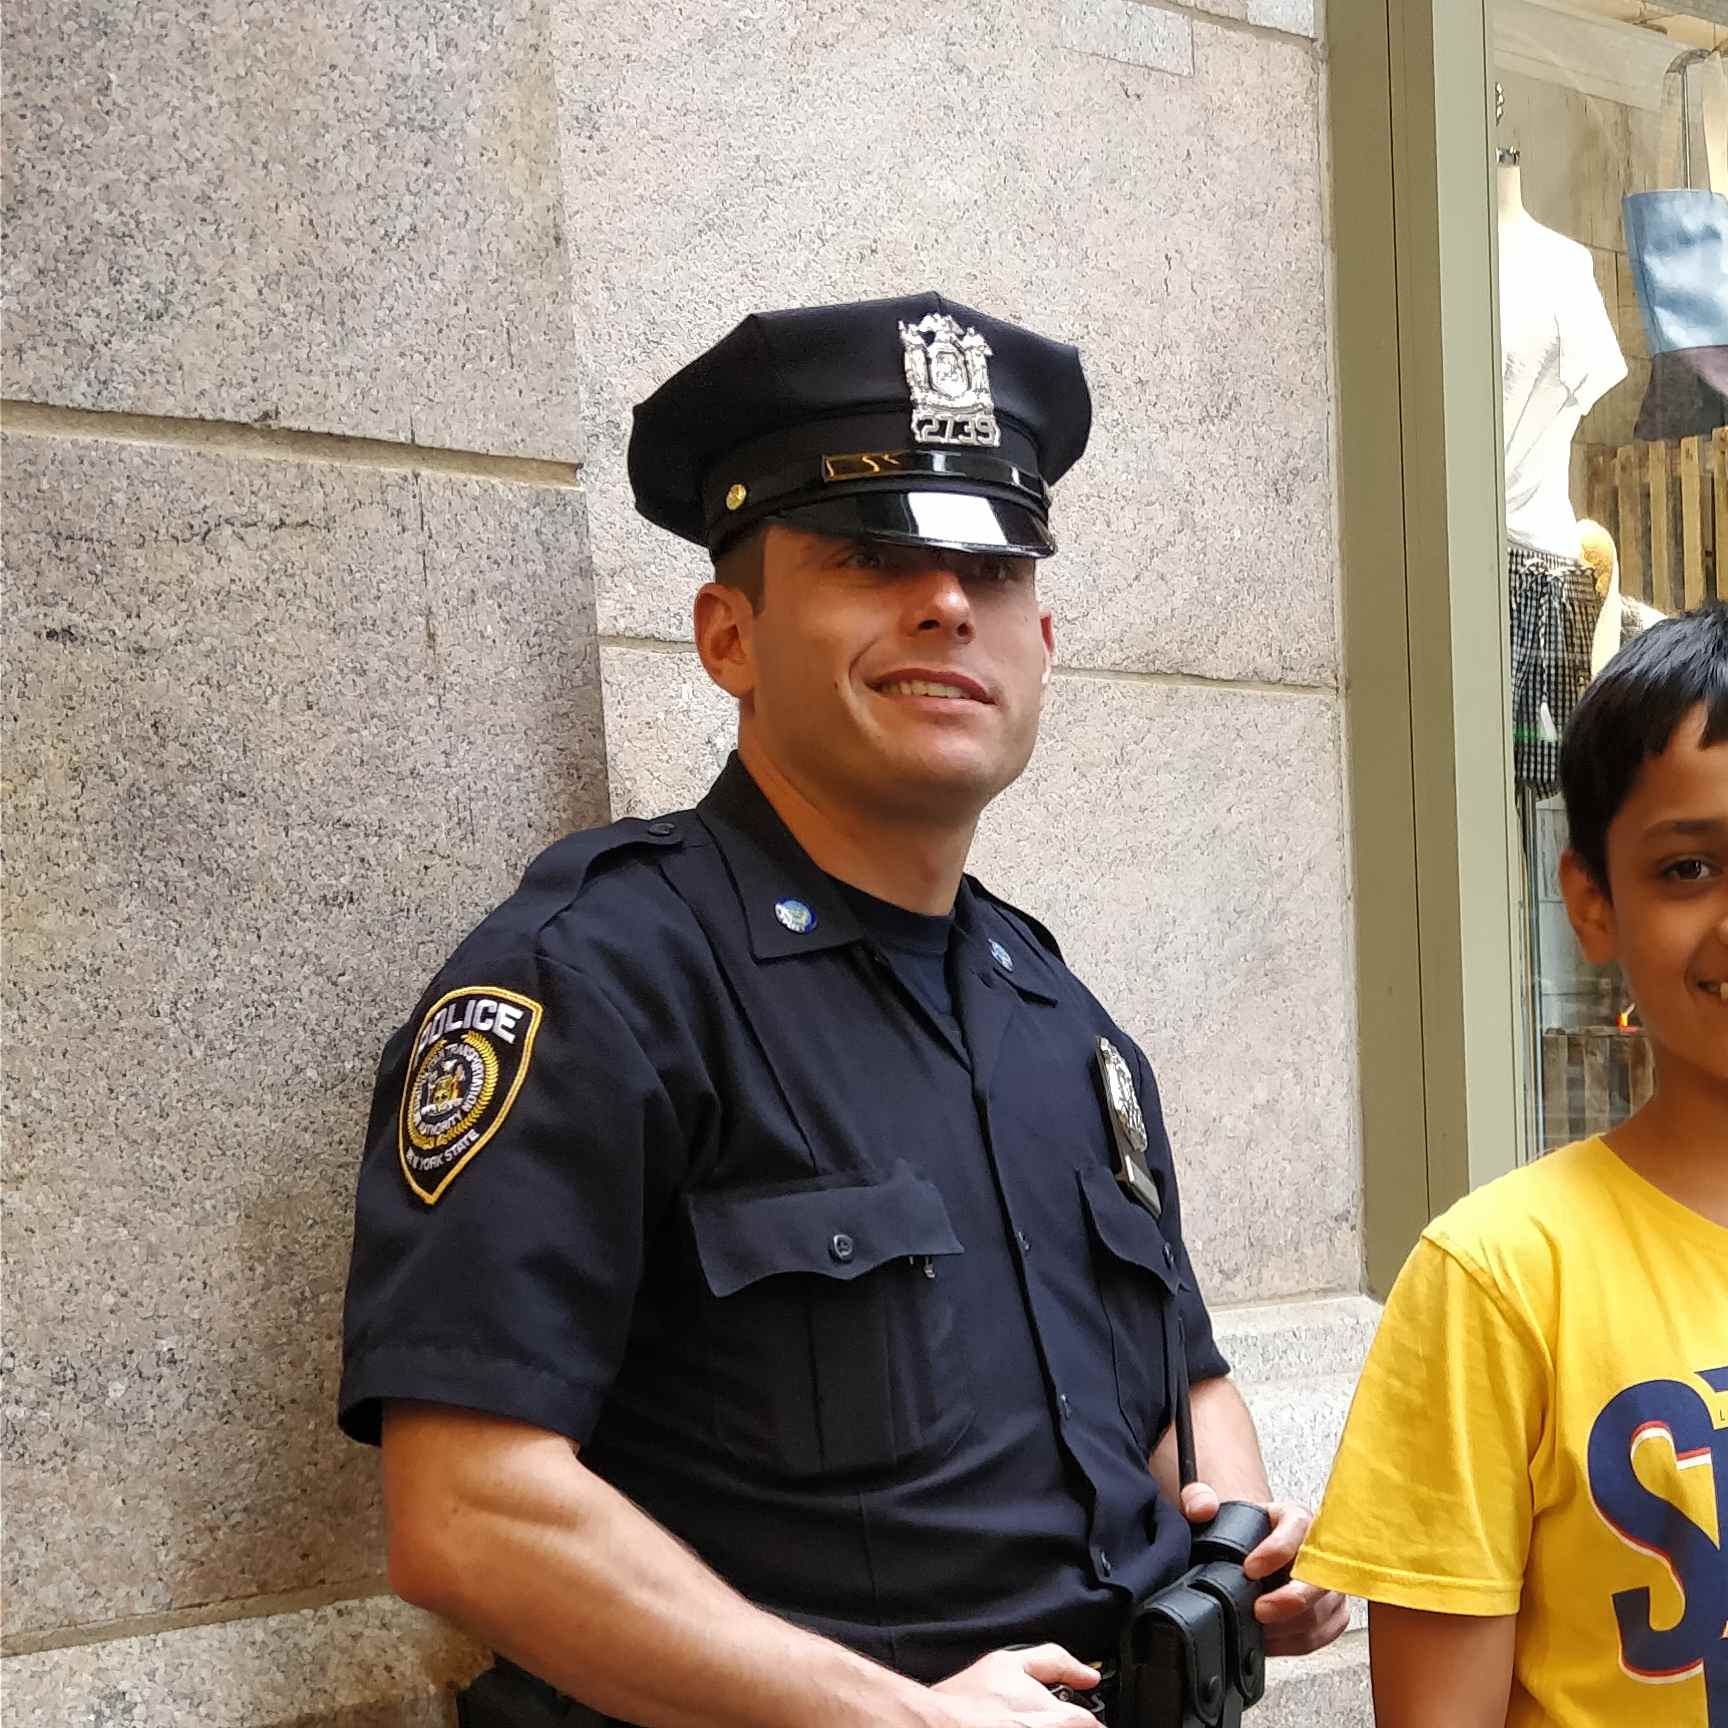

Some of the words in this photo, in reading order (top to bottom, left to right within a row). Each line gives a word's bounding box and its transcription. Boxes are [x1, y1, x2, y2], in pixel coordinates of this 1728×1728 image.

[919, 413, 995, 446] 2739
[415, 998, 525, 1058] POLICE
[444, 1128, 481, 1162] STATE
